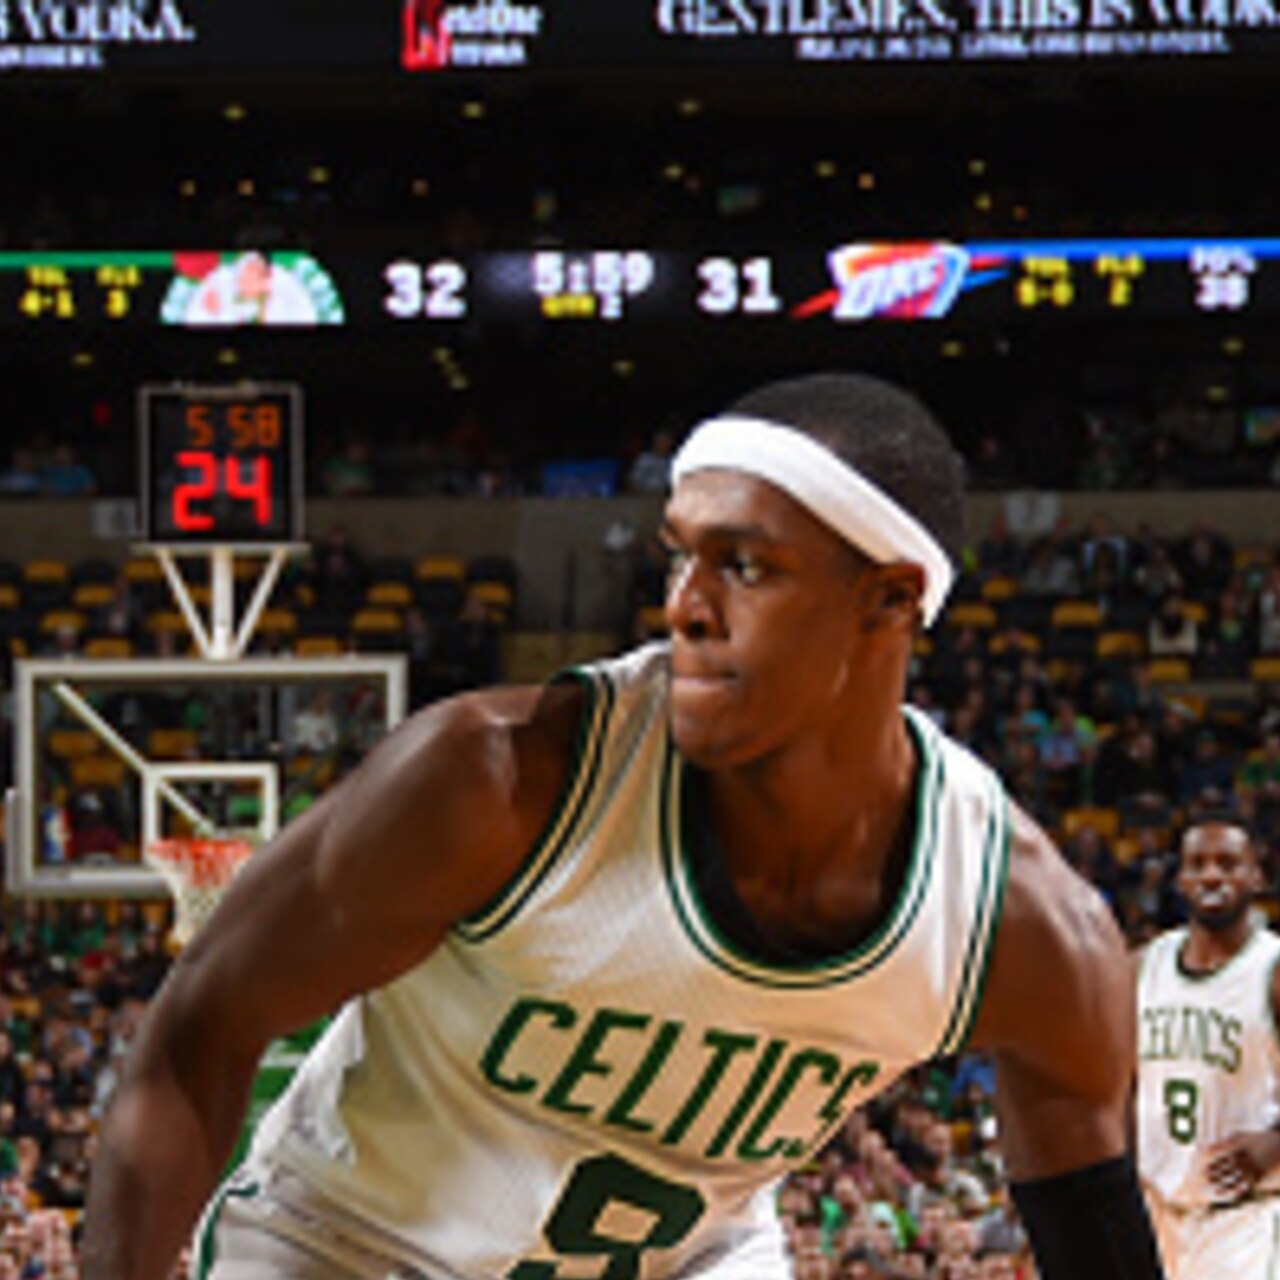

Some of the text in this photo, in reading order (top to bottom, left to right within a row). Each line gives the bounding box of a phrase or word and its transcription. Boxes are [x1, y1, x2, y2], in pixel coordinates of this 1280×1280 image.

[384, 260, 467, 319] 32
[531, 249, 654, 296] 5:59
[695, 256, 781, 313] 31
[171, 450, 274, 531] 24
[1162, 1078, 1198, 1144] 8
